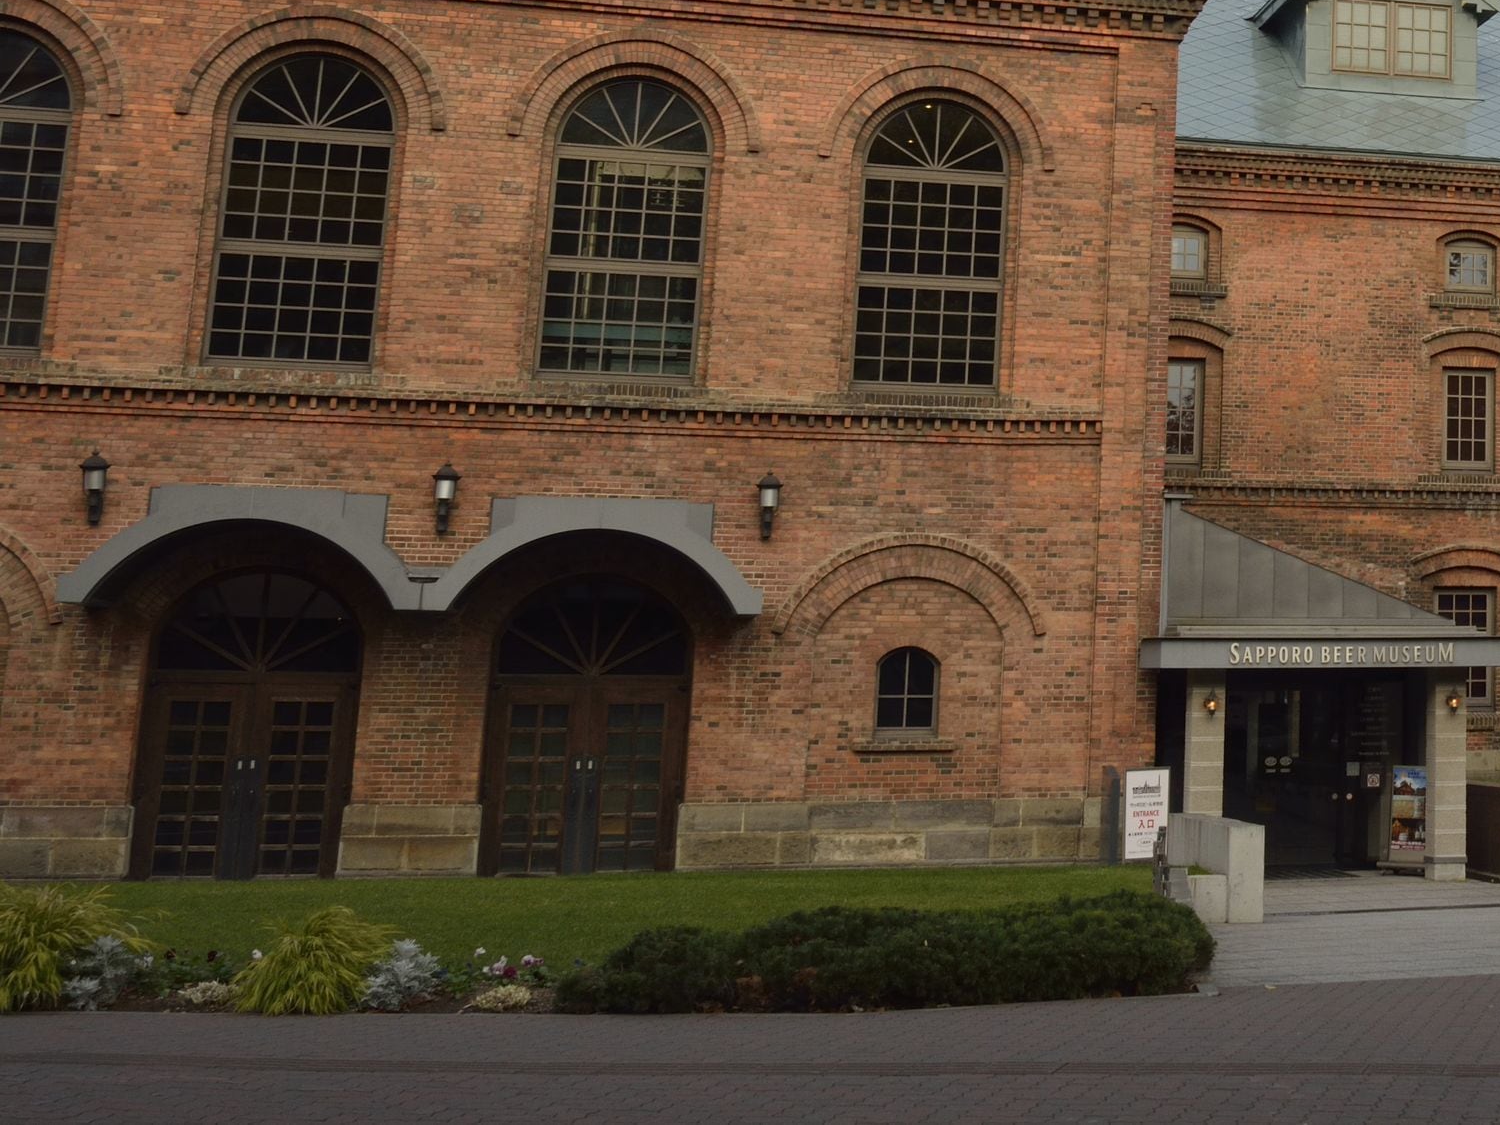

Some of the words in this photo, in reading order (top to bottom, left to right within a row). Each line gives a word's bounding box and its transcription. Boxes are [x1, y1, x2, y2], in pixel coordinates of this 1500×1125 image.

[1229, 642, 1314, 665] SAPPORO
[1321, 645, 1366, 664] BEER
[1373, 642, 1455, 664] MUSEUM
[1138, 819, 1154, 828] 入口
